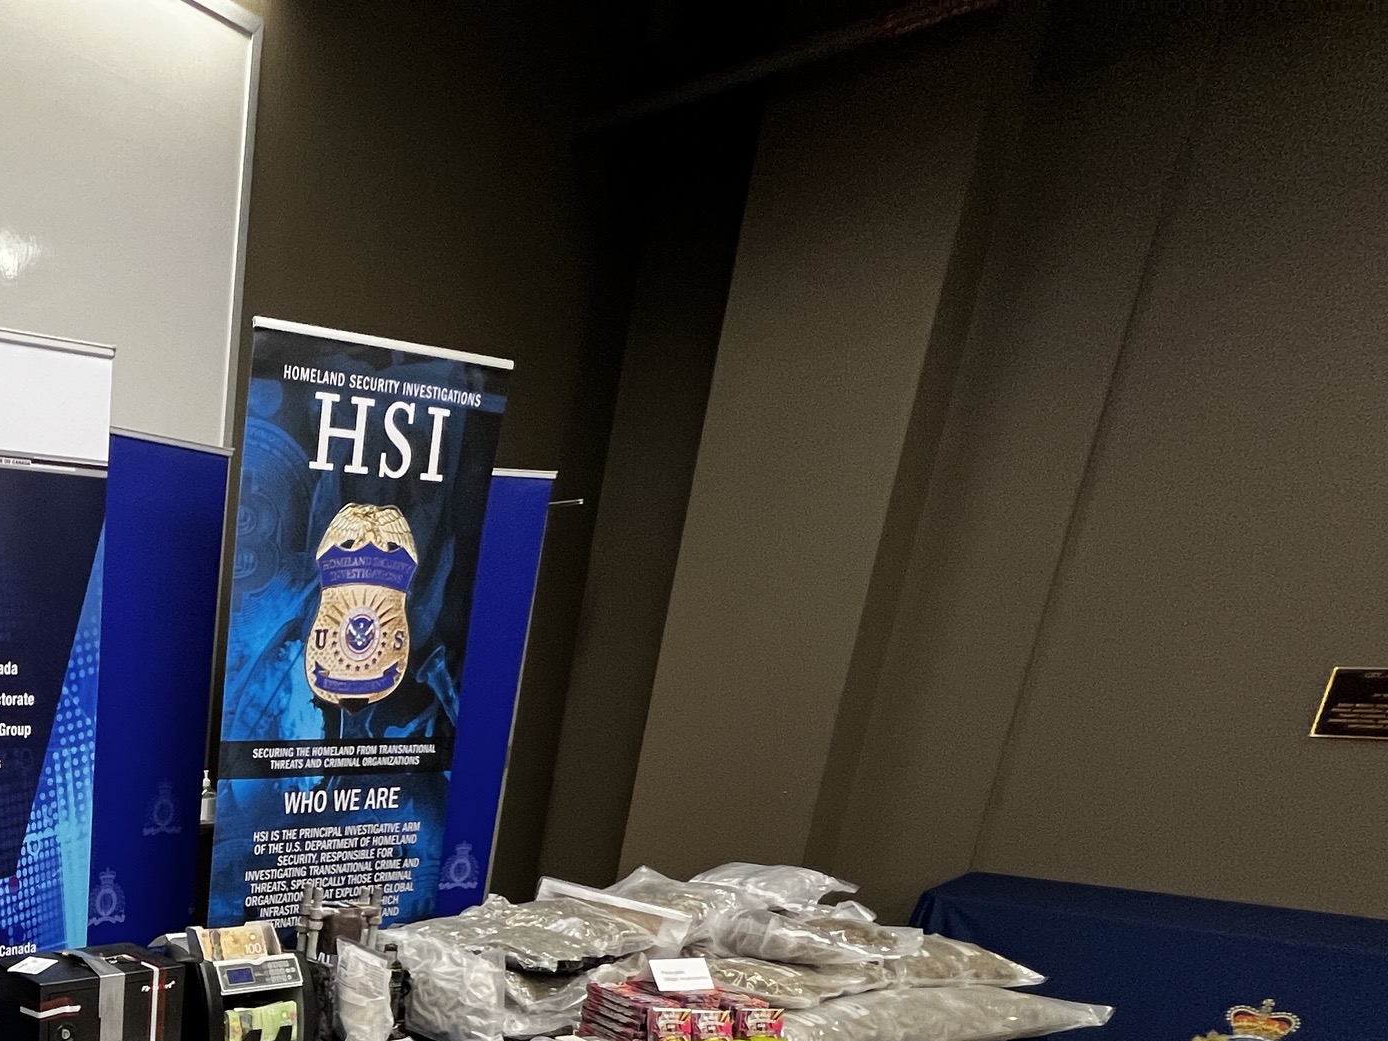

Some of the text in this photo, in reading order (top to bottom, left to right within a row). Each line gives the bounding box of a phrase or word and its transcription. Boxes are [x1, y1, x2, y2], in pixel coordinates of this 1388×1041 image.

[284, 365, 481, 407] HOMELAND SECURITY INVESTIGATIONS
[309, 391, 450, 482] HSI
[253, 744, 436, 759] SECURING THE HOMELAND FROM TRANSNATIONAL
[270, 756, 420, 769] THREATS AND CRIMINAL ORGANIZATIONS
[284, 787, 400, 815] WHO WE ARE
[253, 821, 421, 843] HSI IS THE PRINCIPAL INVESTIGATIVE ARM
[254, 833, 417, 855] OF THE U.S. DEPARTMENT OF HOMELAND
[320, 849, 375, 863] RESPONSIBLE
[376, 847, 393, 858] FOR
[245, 858, 419, 881] INVESTIGATING TRANSNATIONAL CRIME AND
[347, 873, 372, 885] THOSE
[374, 870, 412, 883] CRIMINAL
[245, 892, 301, 907] ORGANIZATION
[384, 882, 414, 894] GLOBAL
[245, 943, 262, 955] 100
